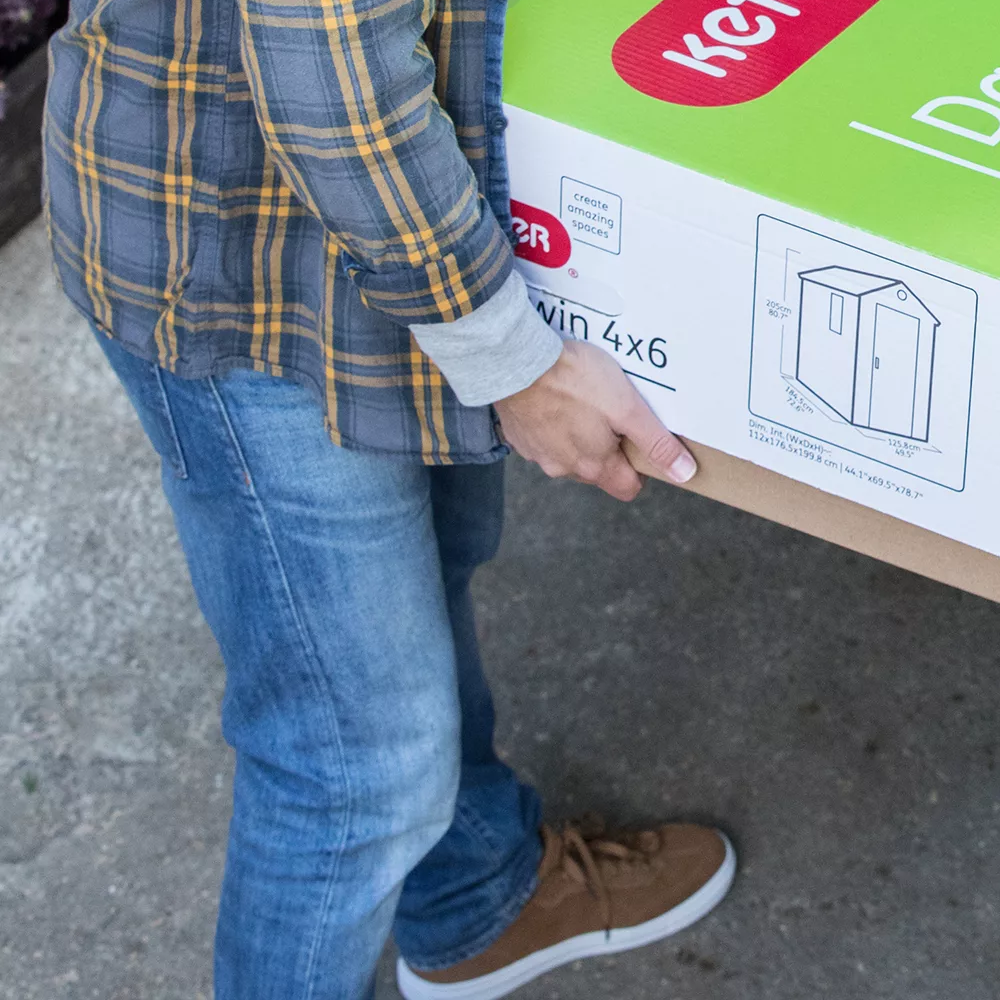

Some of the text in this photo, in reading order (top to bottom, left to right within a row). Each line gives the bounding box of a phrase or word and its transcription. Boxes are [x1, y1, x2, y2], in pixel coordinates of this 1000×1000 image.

[573, 191, 609, 211] create
[567, 203, 614, 229] amazing
[572, 218, 609, 239] spaces
[765, 299, 792, 315] 205cm
[602, 320, 667, 369] 4x6
[748, 418, 768, 433] Dim.
[824, 459, 838, 469] cm
